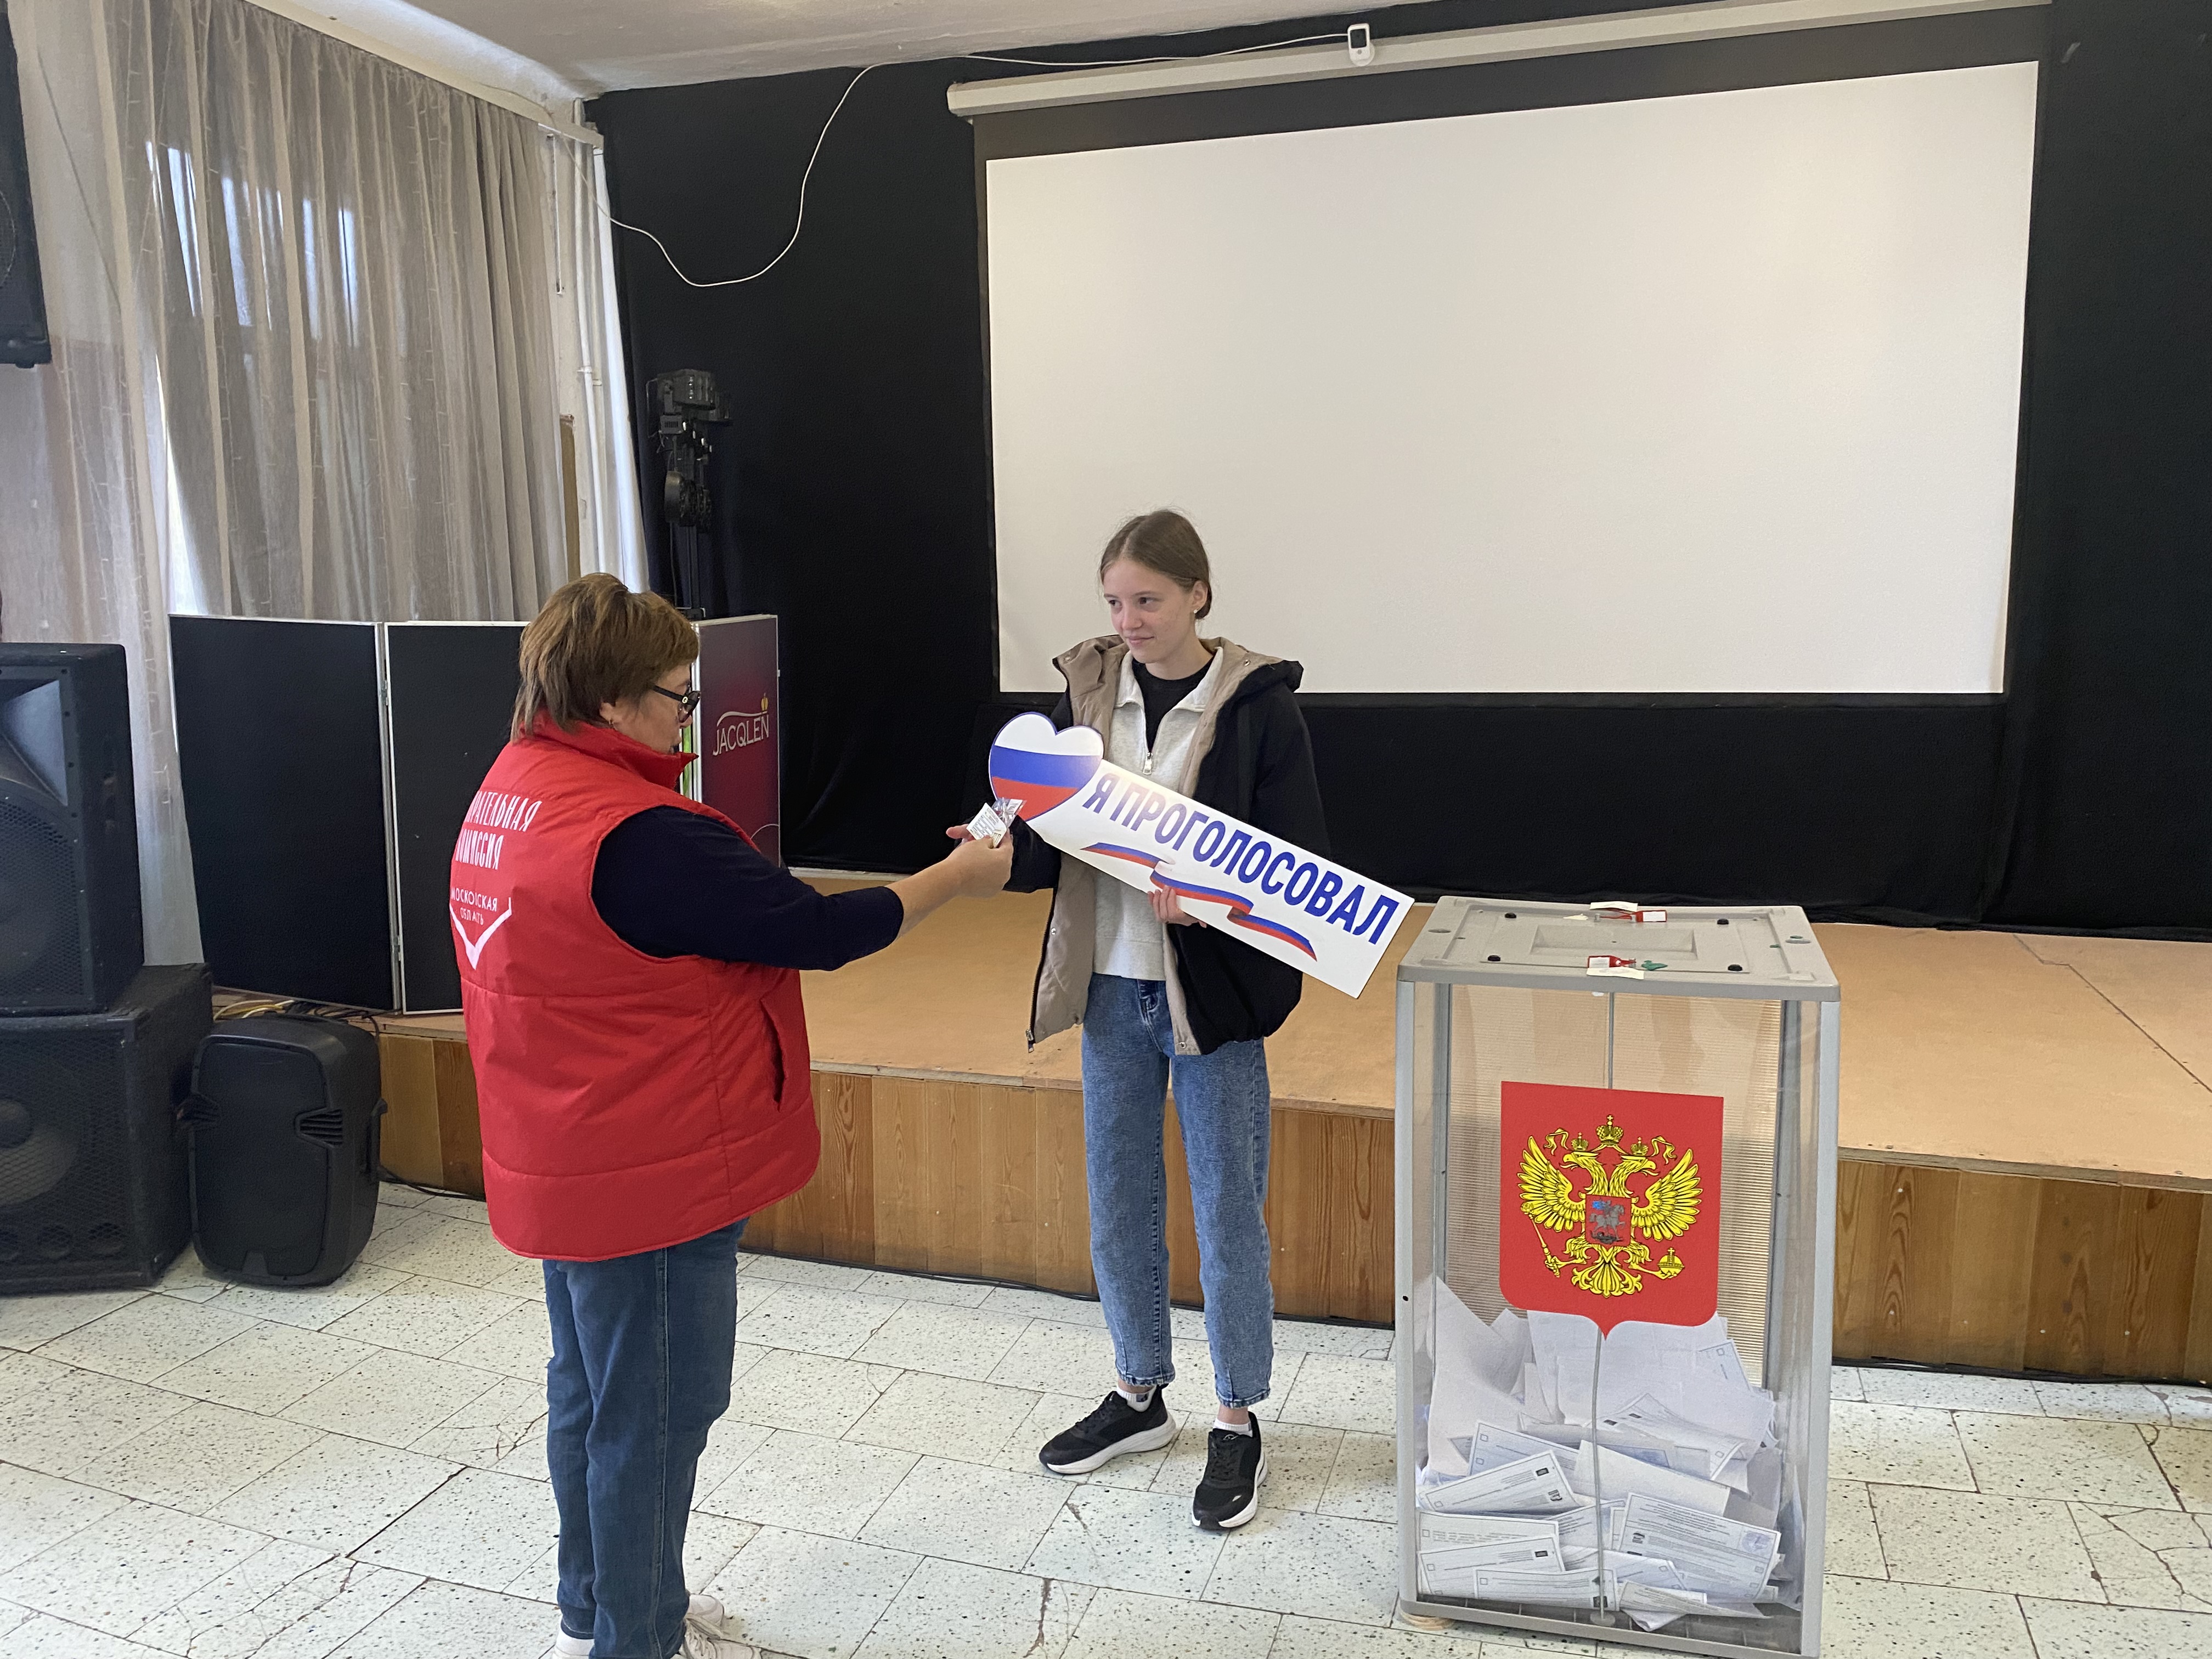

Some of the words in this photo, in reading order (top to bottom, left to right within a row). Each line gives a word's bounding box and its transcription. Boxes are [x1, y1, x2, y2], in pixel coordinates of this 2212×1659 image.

[464, 791, 543, 832] РАТЕЛЬНАЯ
[1082, 772, 1120, 814] Я
[1109, 782, 1400, 945] ПРОГОЛОСОВАЛ
[460, 907, 484, 926] ОБЛАТЬ
